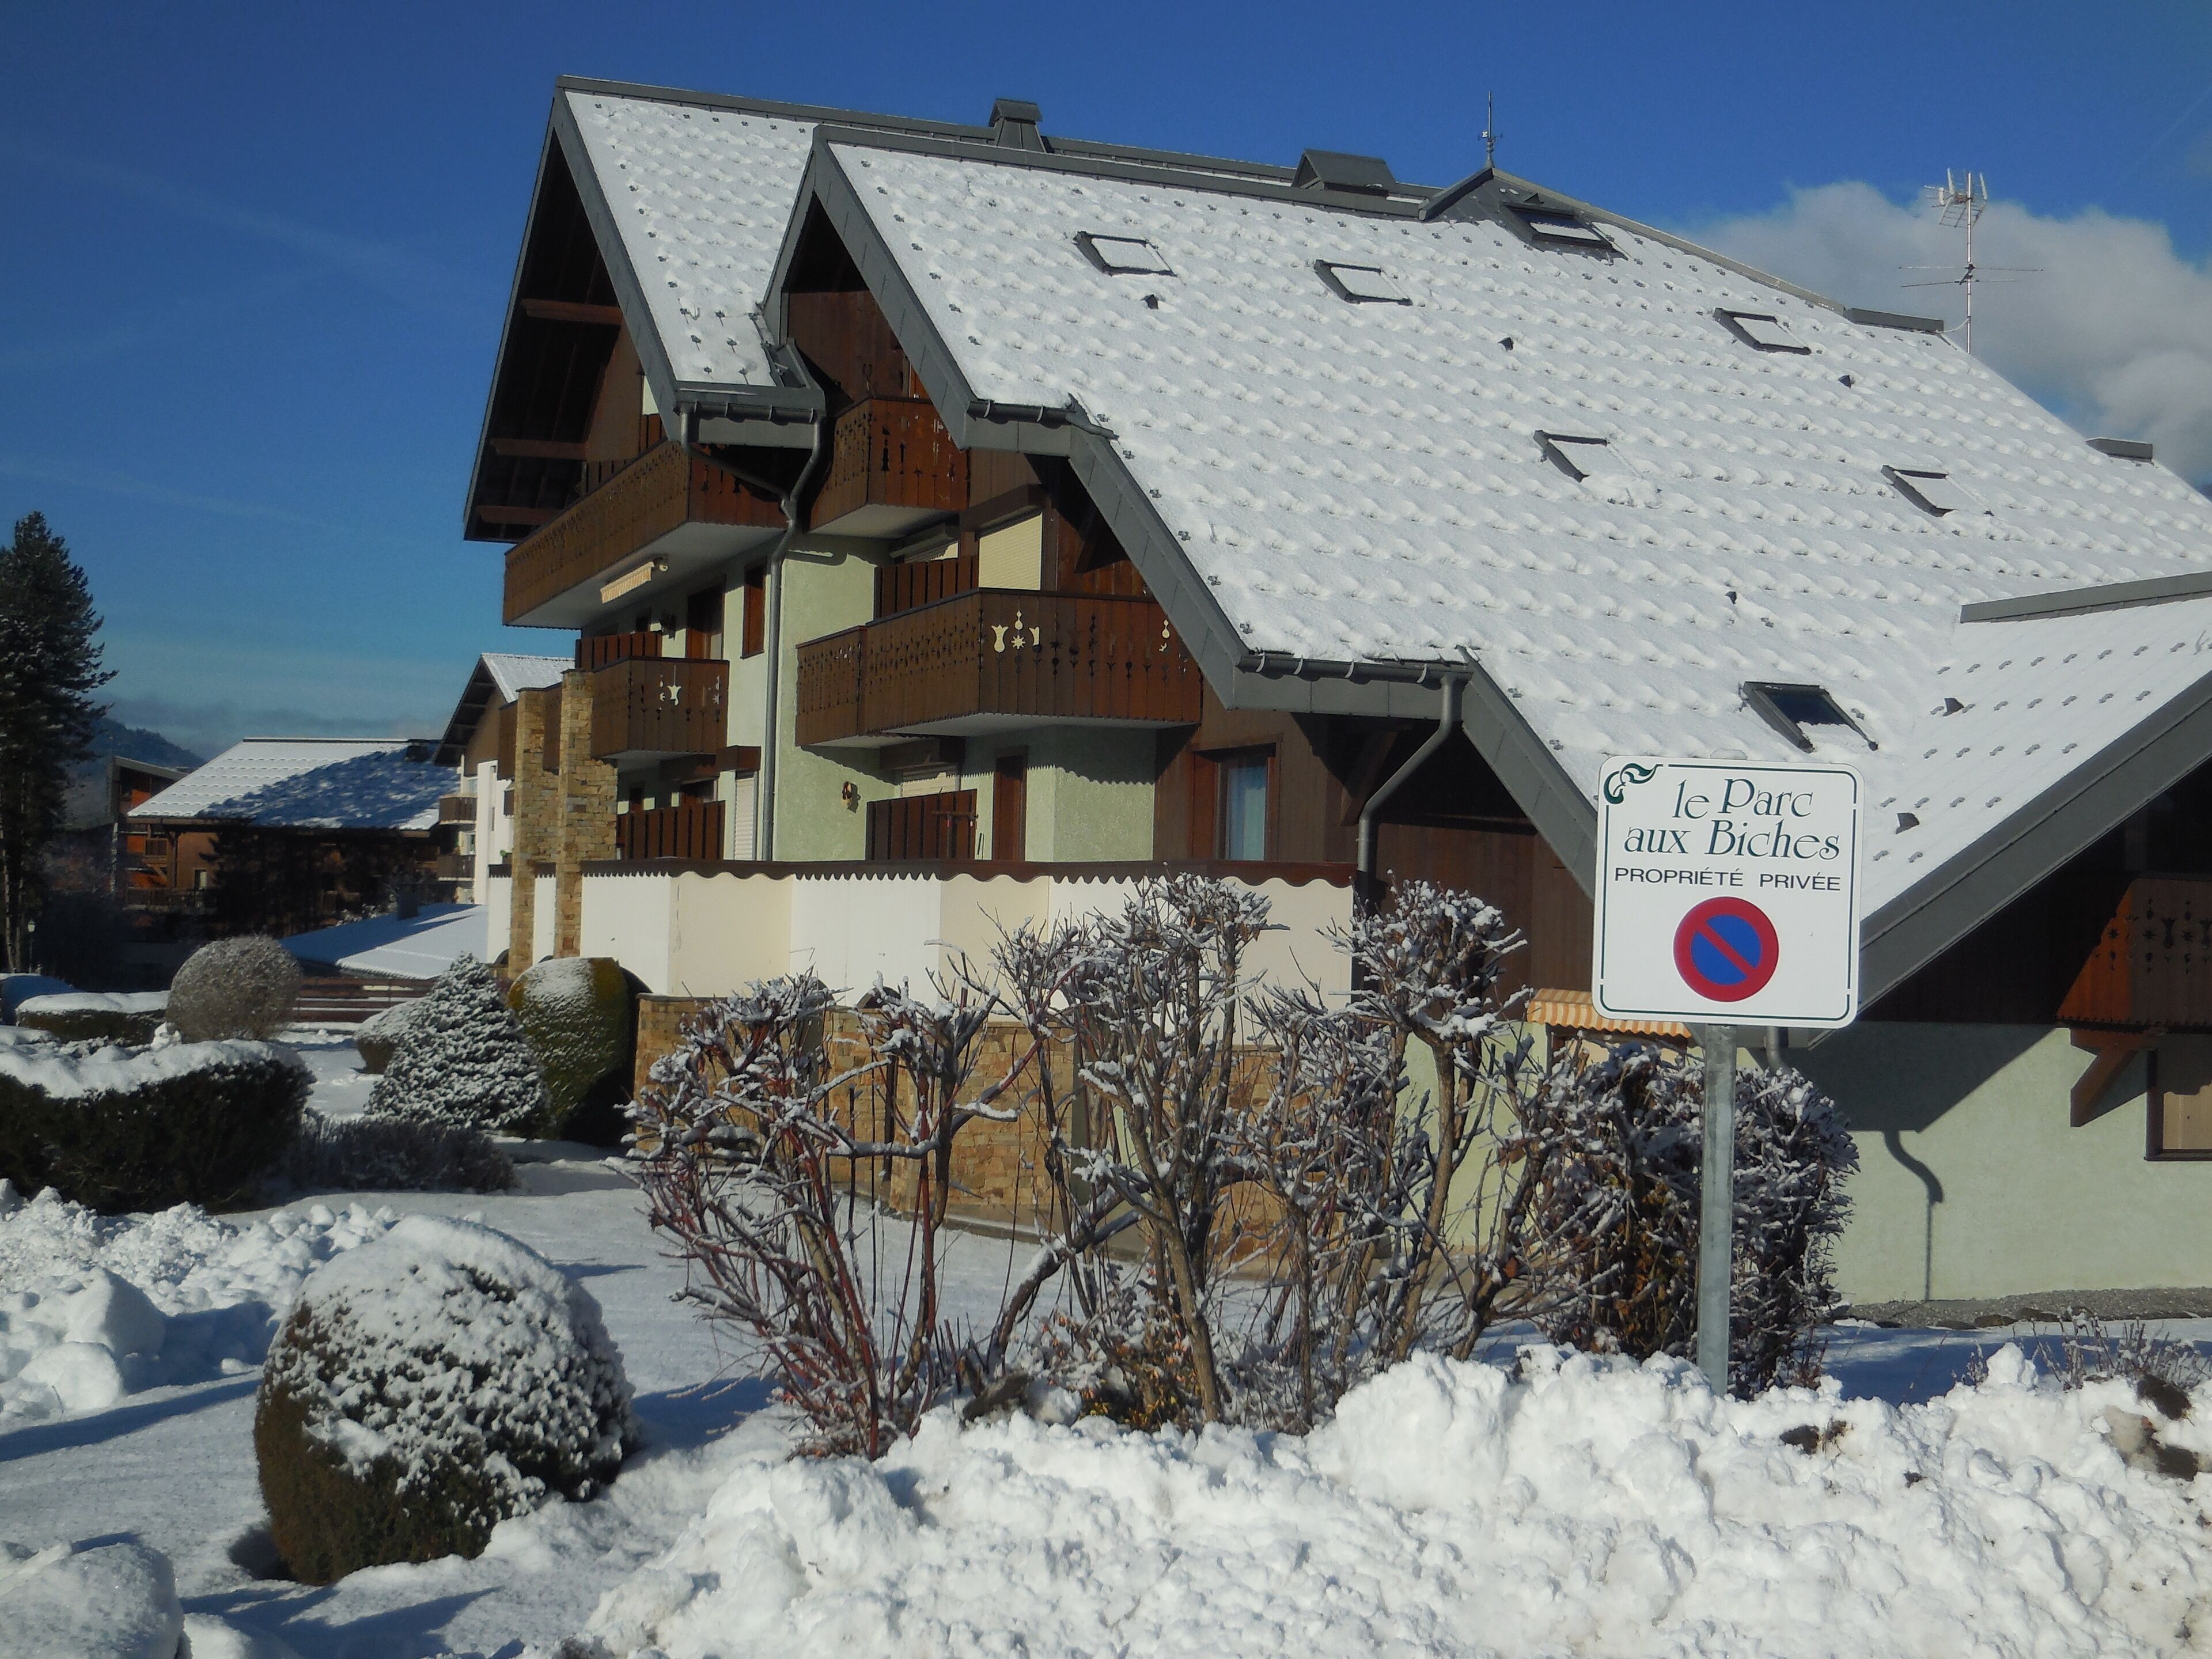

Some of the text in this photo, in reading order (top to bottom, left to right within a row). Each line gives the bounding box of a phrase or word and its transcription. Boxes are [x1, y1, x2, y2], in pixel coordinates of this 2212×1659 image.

[1672, 778, 1813, 819] le Parc
[1623, 819, 1840, 860] aux Biches
[1614, 867, 1841, 891] PROPRIÉTÉ PRIVÉE
